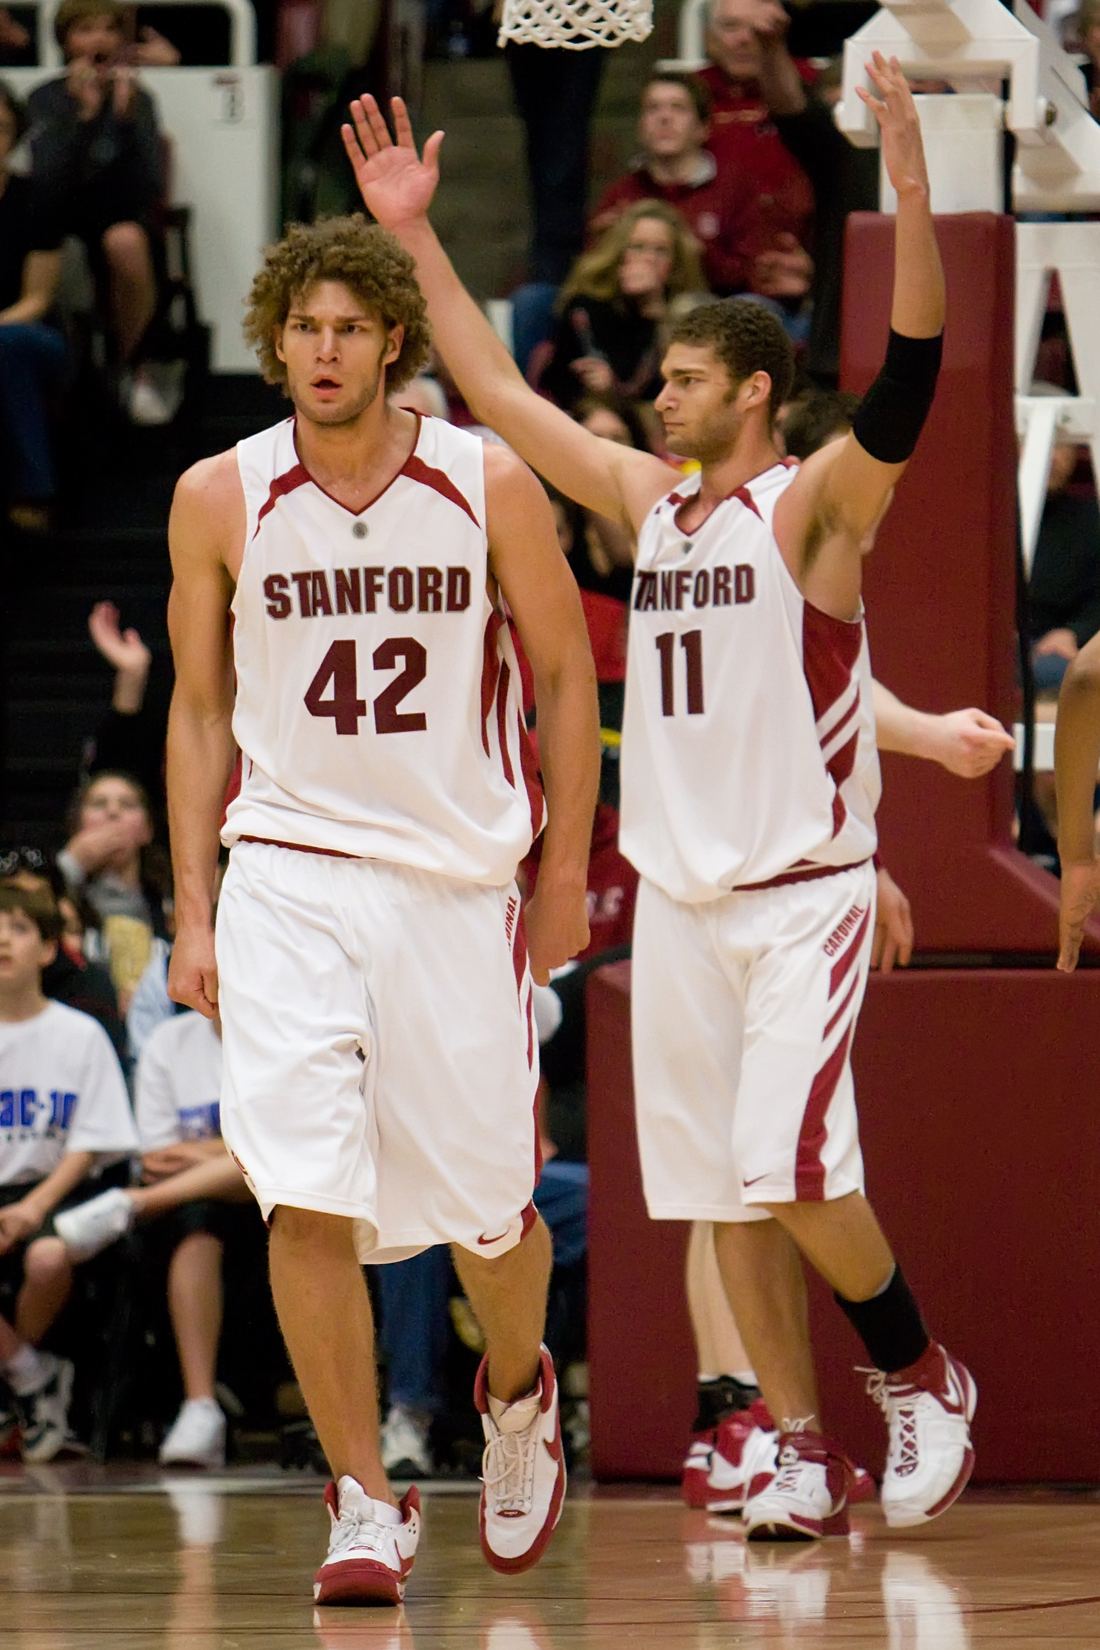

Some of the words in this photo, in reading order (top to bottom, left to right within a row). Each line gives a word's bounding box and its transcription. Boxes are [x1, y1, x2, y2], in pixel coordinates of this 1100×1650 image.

[263, 565, 472, 621] STANFORD
[303, 636, 428, 736] 42
[655, 629, 705, 717] 11
[504, 895, 518, 945] DINAL
[822, 904, 865, 958] CARDINAL
